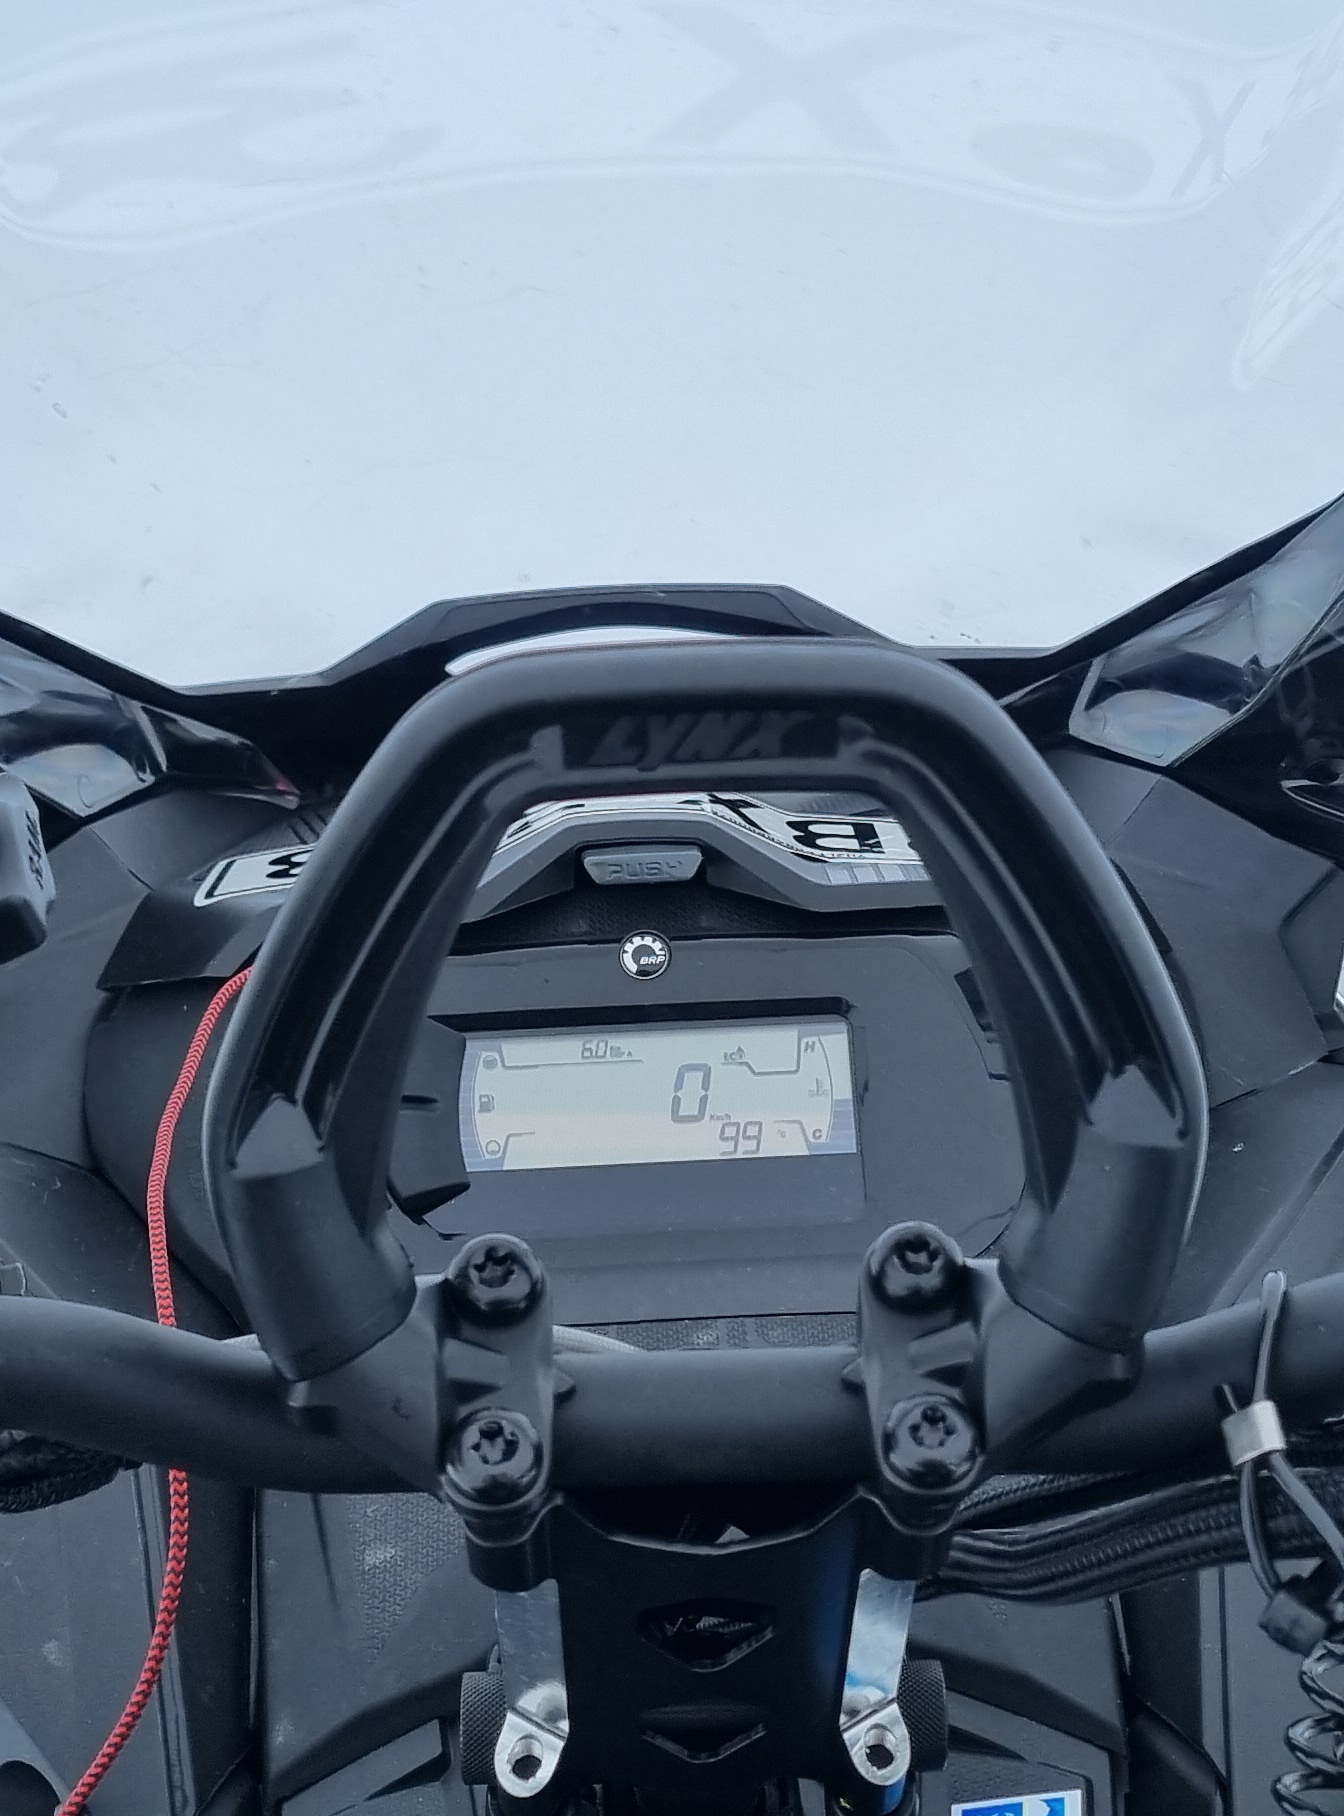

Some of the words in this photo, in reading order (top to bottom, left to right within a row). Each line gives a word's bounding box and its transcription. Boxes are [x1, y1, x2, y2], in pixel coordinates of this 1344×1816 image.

[588, 710, 814, 772] LYNX
[639, 955, 666, 965] BRP
[804, 1041, 816, 1053] H
[671, 1063, 712, 1124] 0
[719, 1121, 763, 1156] 99
